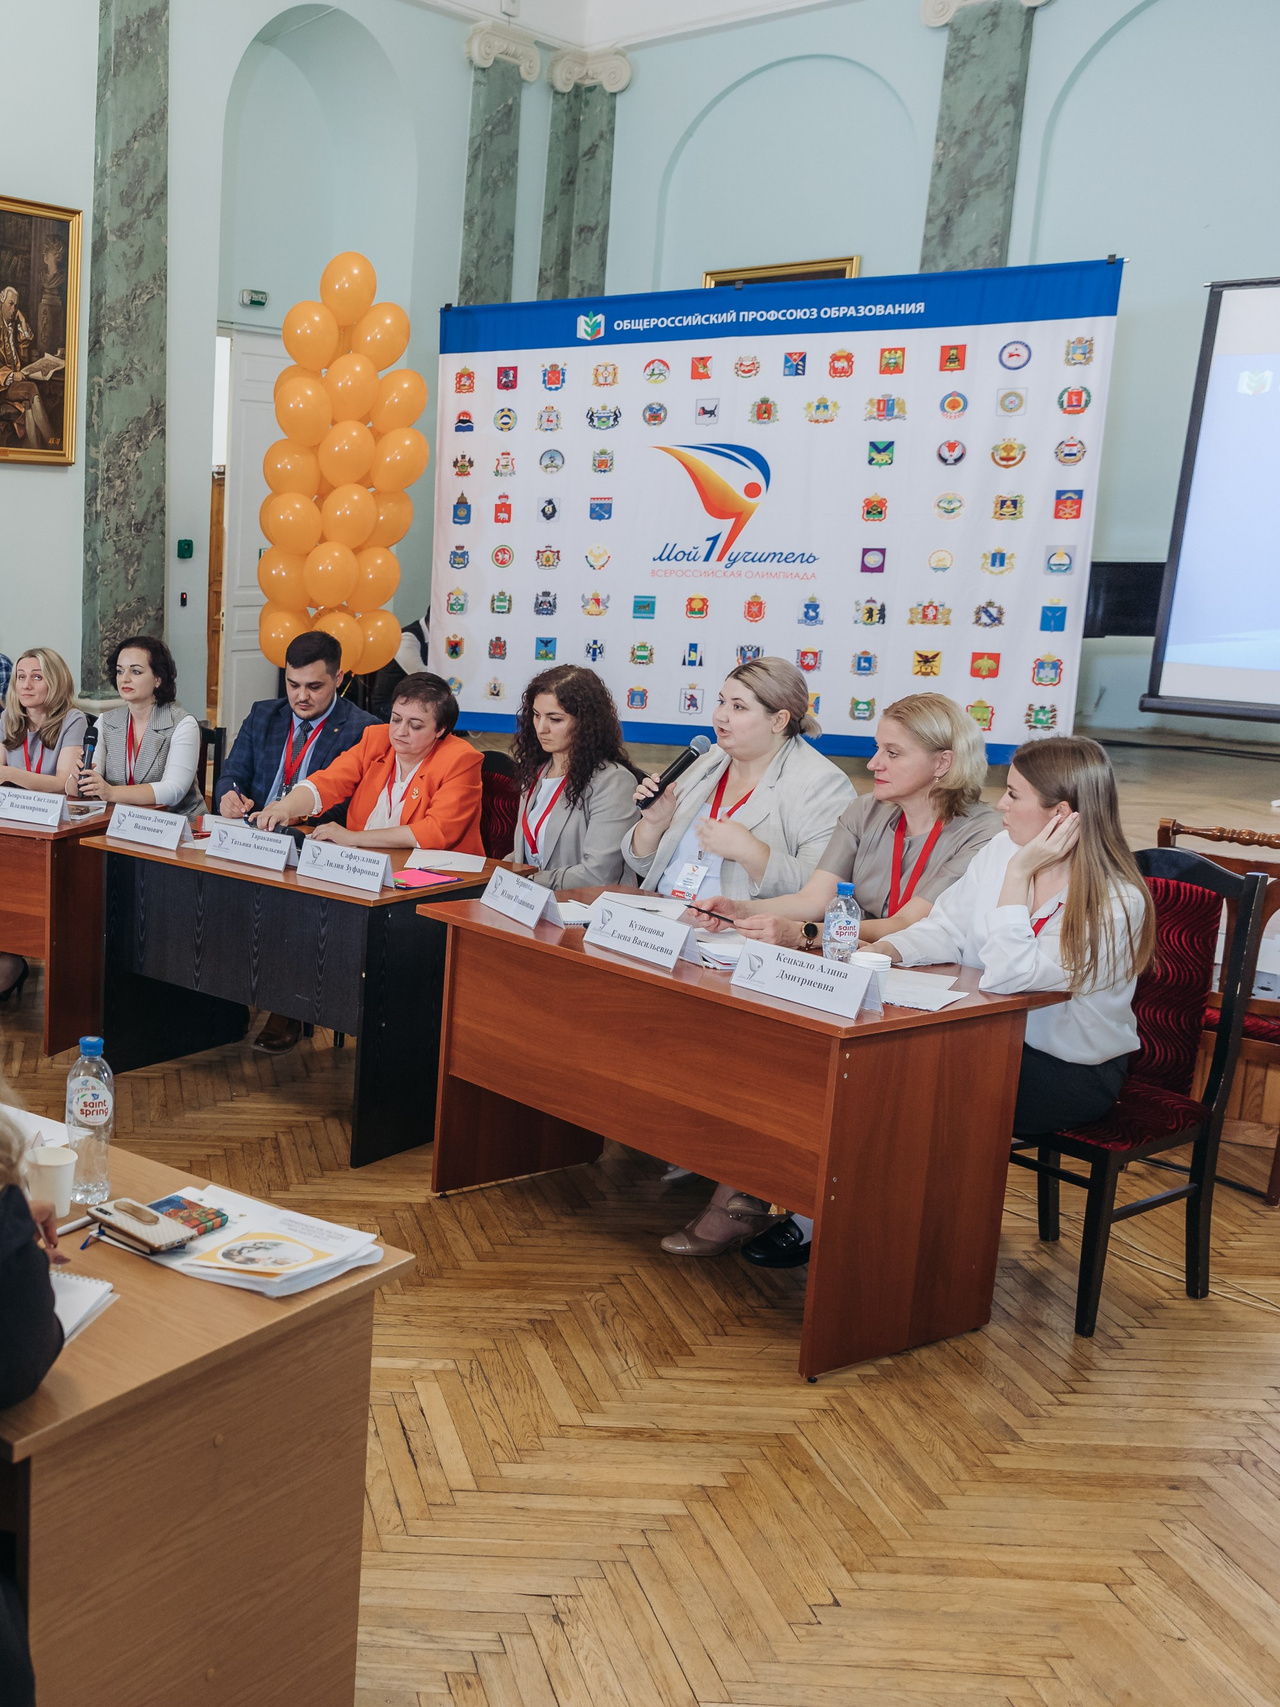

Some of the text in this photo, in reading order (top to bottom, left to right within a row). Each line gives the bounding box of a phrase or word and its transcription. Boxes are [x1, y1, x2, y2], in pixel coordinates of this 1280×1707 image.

[613, 302, 926, 332] ОБЩЕРОССИЙСКИЙ ПРОФСОЮЗ ОБРАЗОВАНИЯ
[652, 542, 701, 562] Мой
[724, 550, 820, 569] учитель
[650, 568, 817, 581] ВСЕРОССИЙСКАЯ ОЛИМПИАДА
[340, 850, 380, 865] Сафиуллина
[345, 864, 379, 878] Зуфаровна
[628, 919, 665, 938] Кузнецова
[835, 930, 857, 938] spring
[610, 929, 631, 942] Елена
[631, 935, 673, 956] Васильевна
[775, 952, 848, 980] Кецкало Алина
[775, 969, 835, 993] Дмитриевна
[82, 1099, 107, 1108] saint
[79, 1107, 109, 1118] spring
